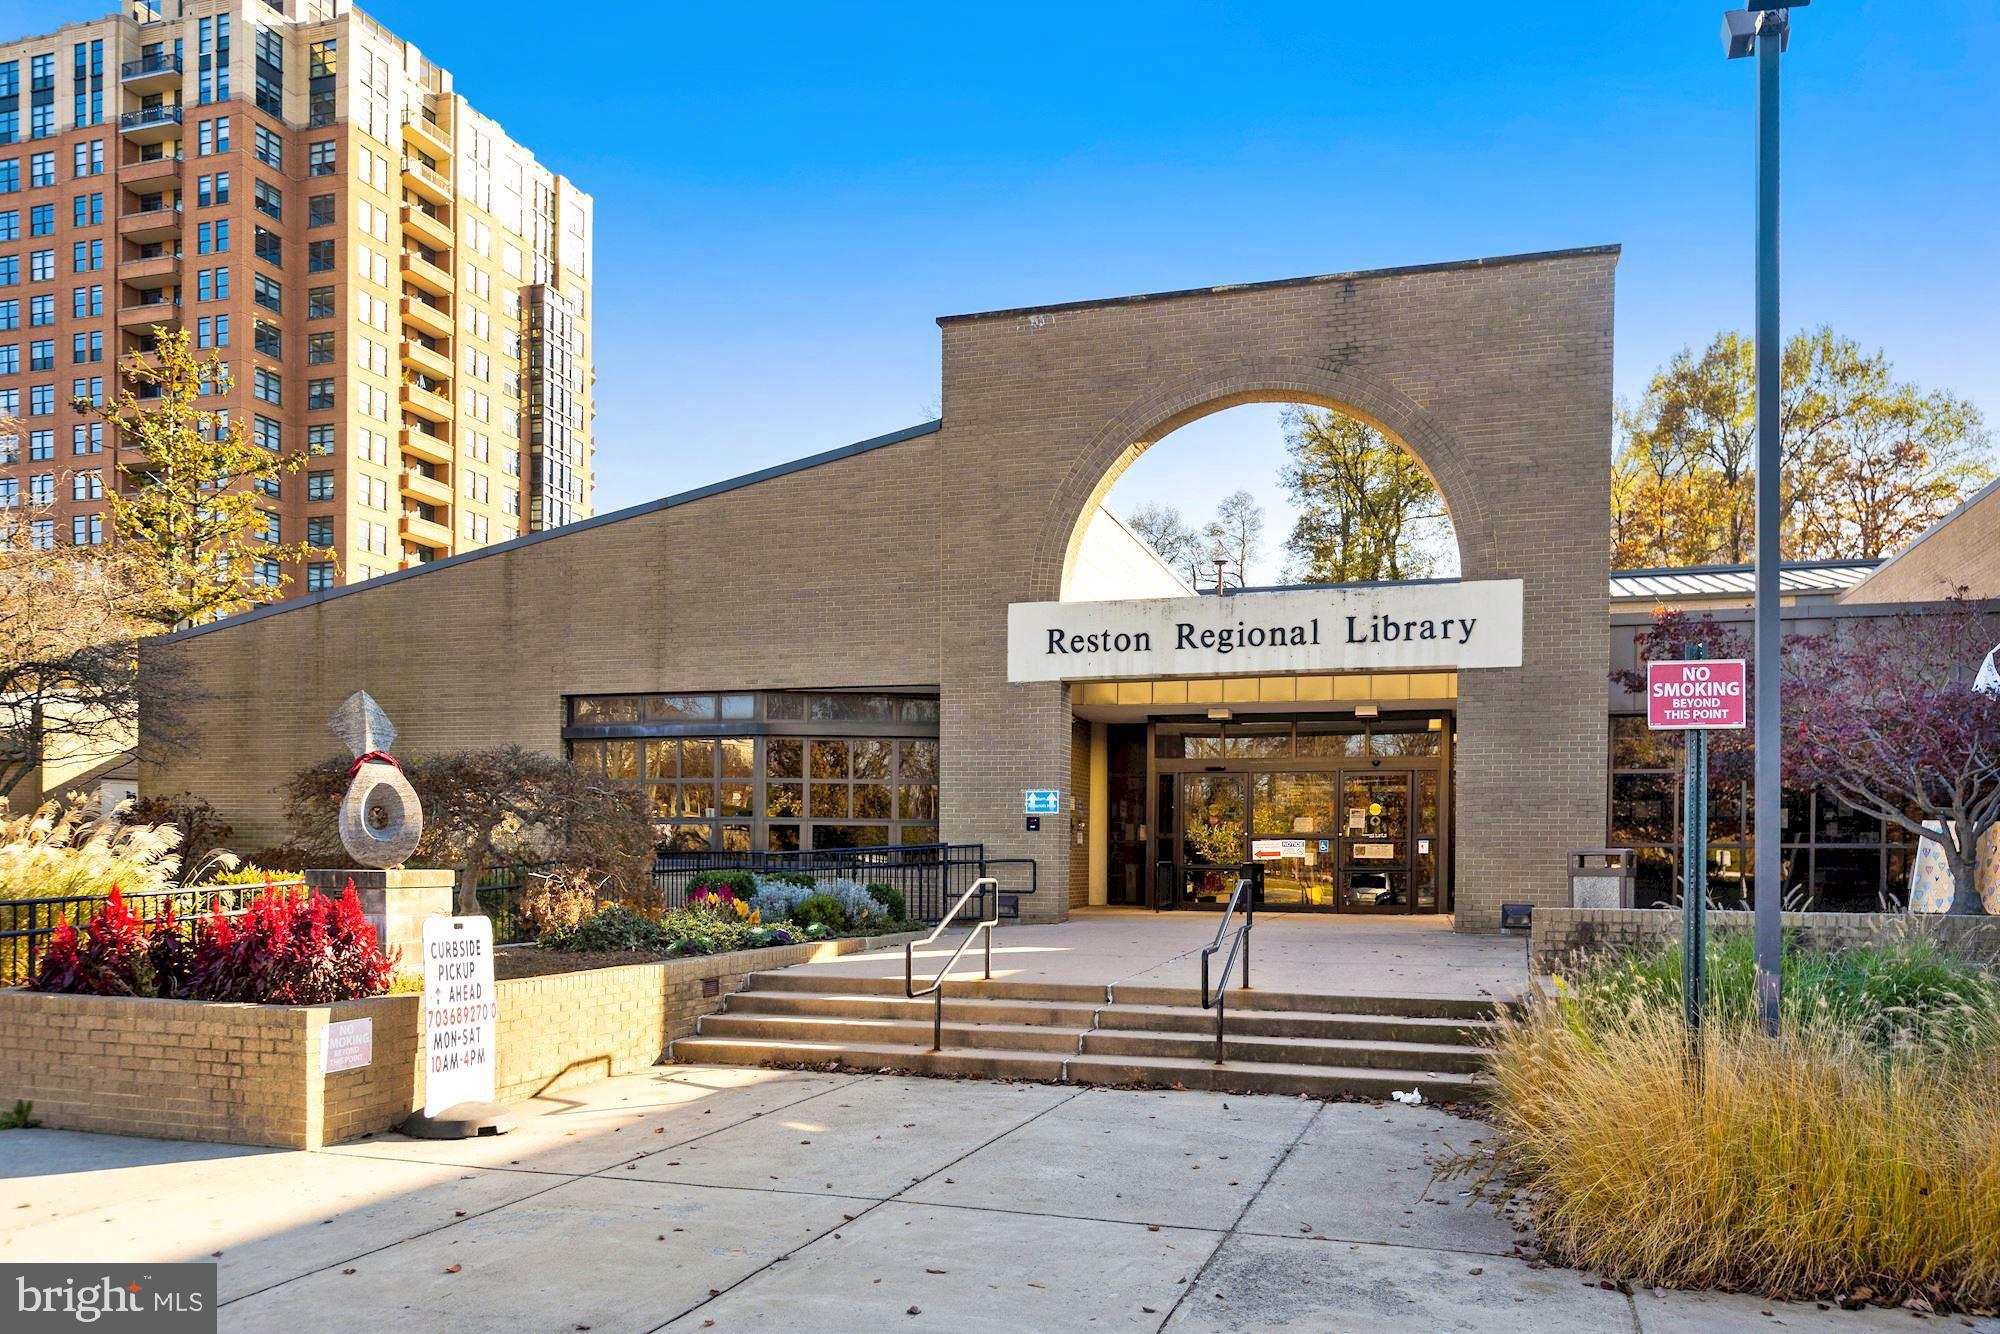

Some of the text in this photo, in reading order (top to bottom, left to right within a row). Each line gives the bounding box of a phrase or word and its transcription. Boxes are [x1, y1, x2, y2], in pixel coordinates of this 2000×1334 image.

[1046, 614, 1477, 654] Reston Regional Library
[1682, 666, 1711, 681] NO
[1653, 681, 1740, 697] SMOKING
[1672, 698, 1721, 708] BEYOND
[1664, 709, 1729, 720] THIS POINT
[431, 940, 481, 959] CURBSIDE
[438, 962, 475, 981] PICKUP
[449, 983, 482, 1003] AHEAD
[339, 1025, 353, 1036] NO
[433, 1027, 481, 1050] MON-SAT
[329, 1033, 370, 1049] MOKING
[431, 1048, 485, 1073] 10AM-4PM
